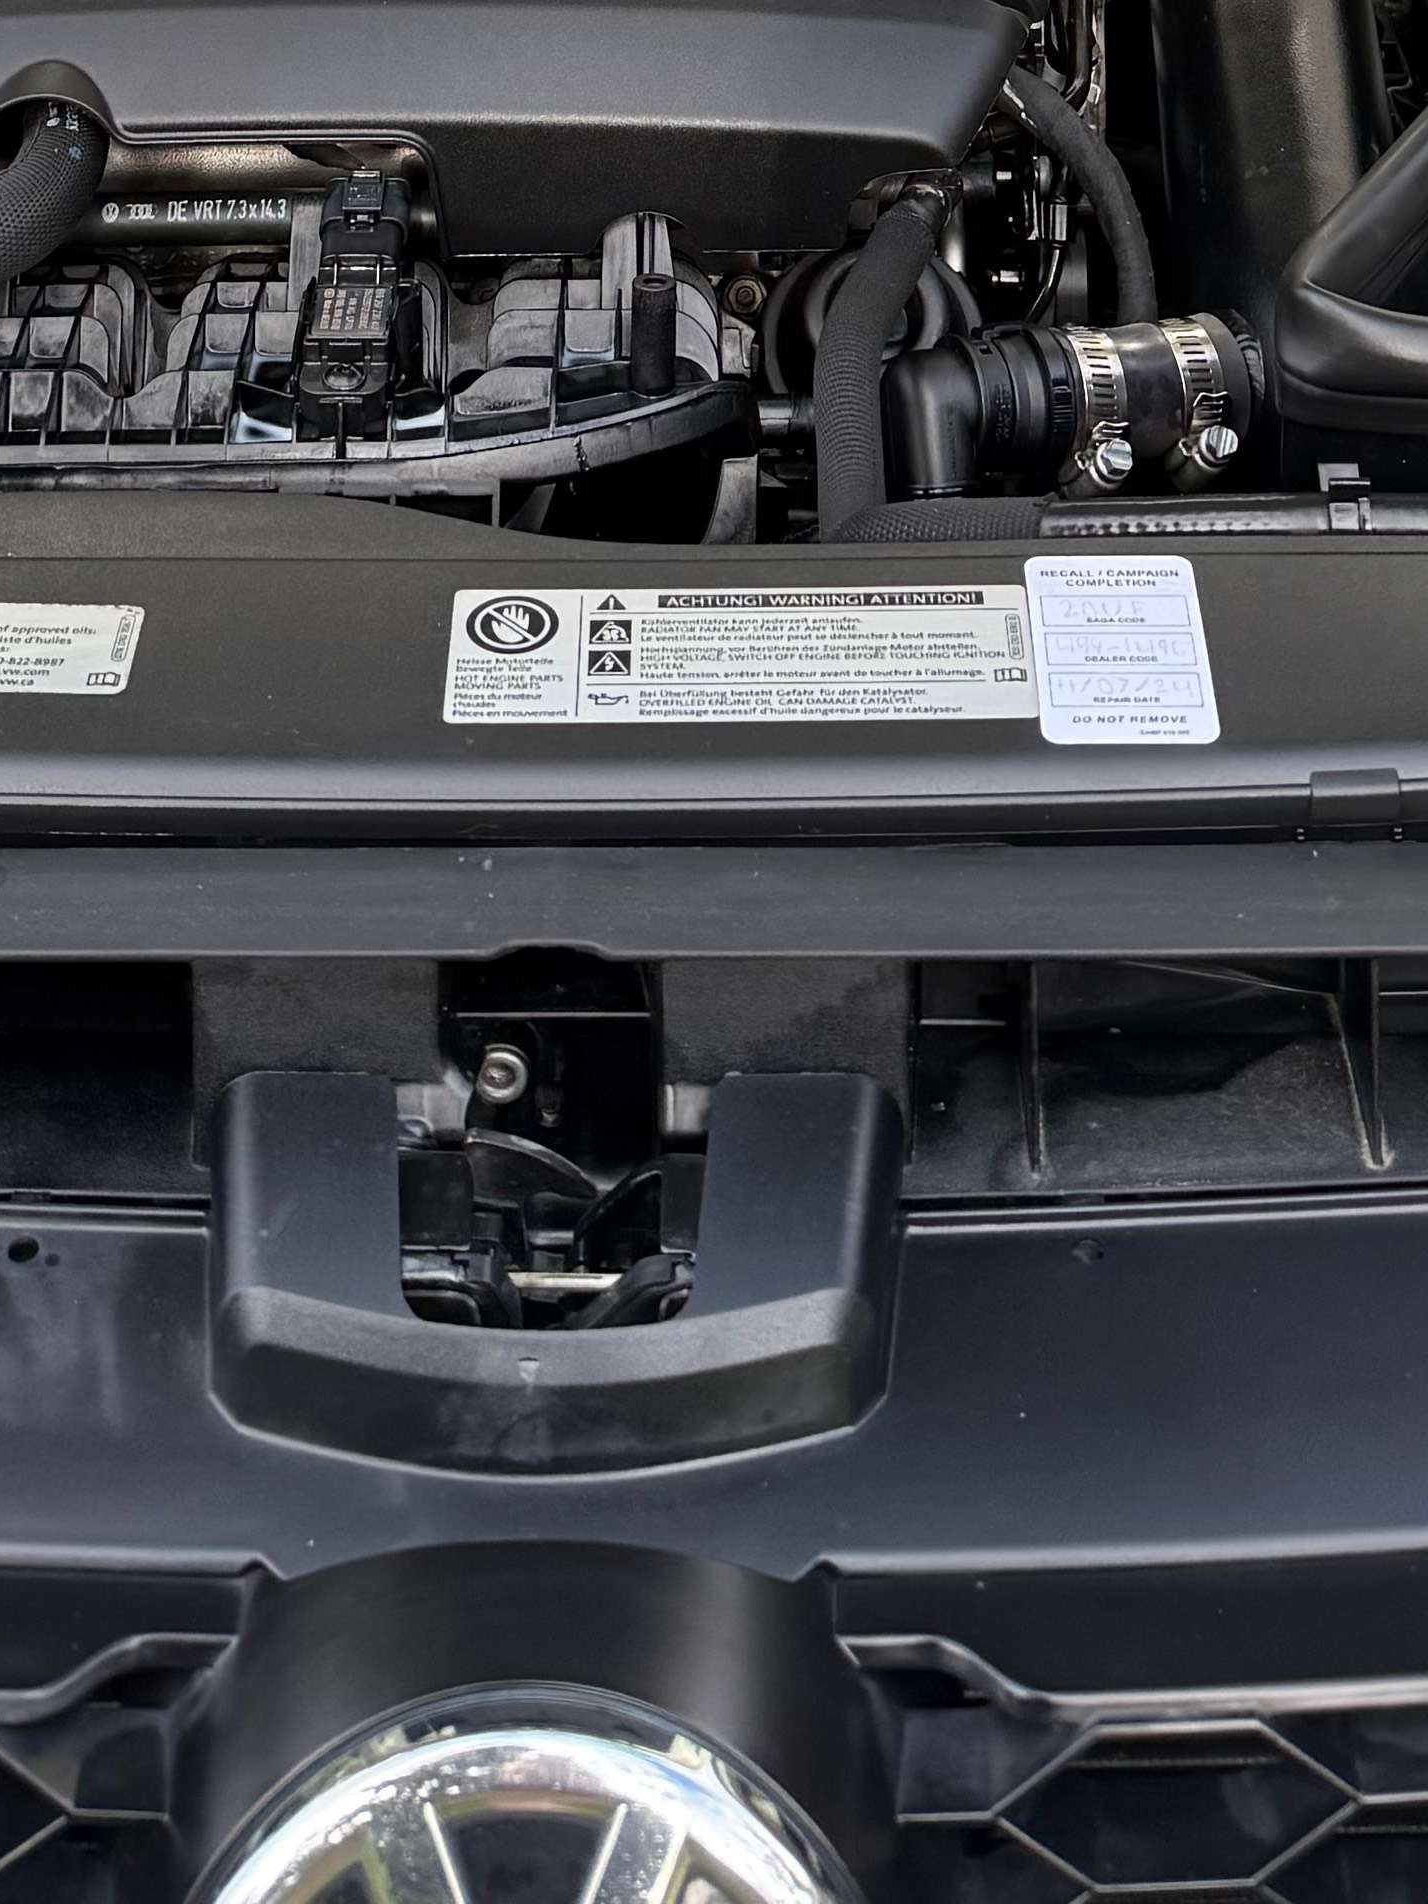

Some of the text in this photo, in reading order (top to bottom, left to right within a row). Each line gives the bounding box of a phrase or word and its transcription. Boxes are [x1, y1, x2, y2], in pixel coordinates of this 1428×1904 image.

[167, 200, 188, 222] DE
[194, 199, 222, 220] VRT
[1106, 569, 1179, 577] CAMPAIGN
[666, 593, 976, 607] ACHTUNG! WARNING! ATTENTION!
[11, 625, 69, 636] approved
[25, 635, 72, 645] d'huiles
[787, 634, 813, 642] peut
[774, 653, 795, 661] OFF
[724, 670, 761, 678] arrêter
[916, 668, 922, 676] à
[639, 690, 657, 698] Bei
[776, 689, 814, 697] Gefahr
[820, 688, 835, 696] für
[639, 709, 710, 717] Remplissage
[801, 708, 861, 716] dangereux
[864, 707, 891, 716] pour
[1073, 715, 1187, 724] DO NOT REMOVE
